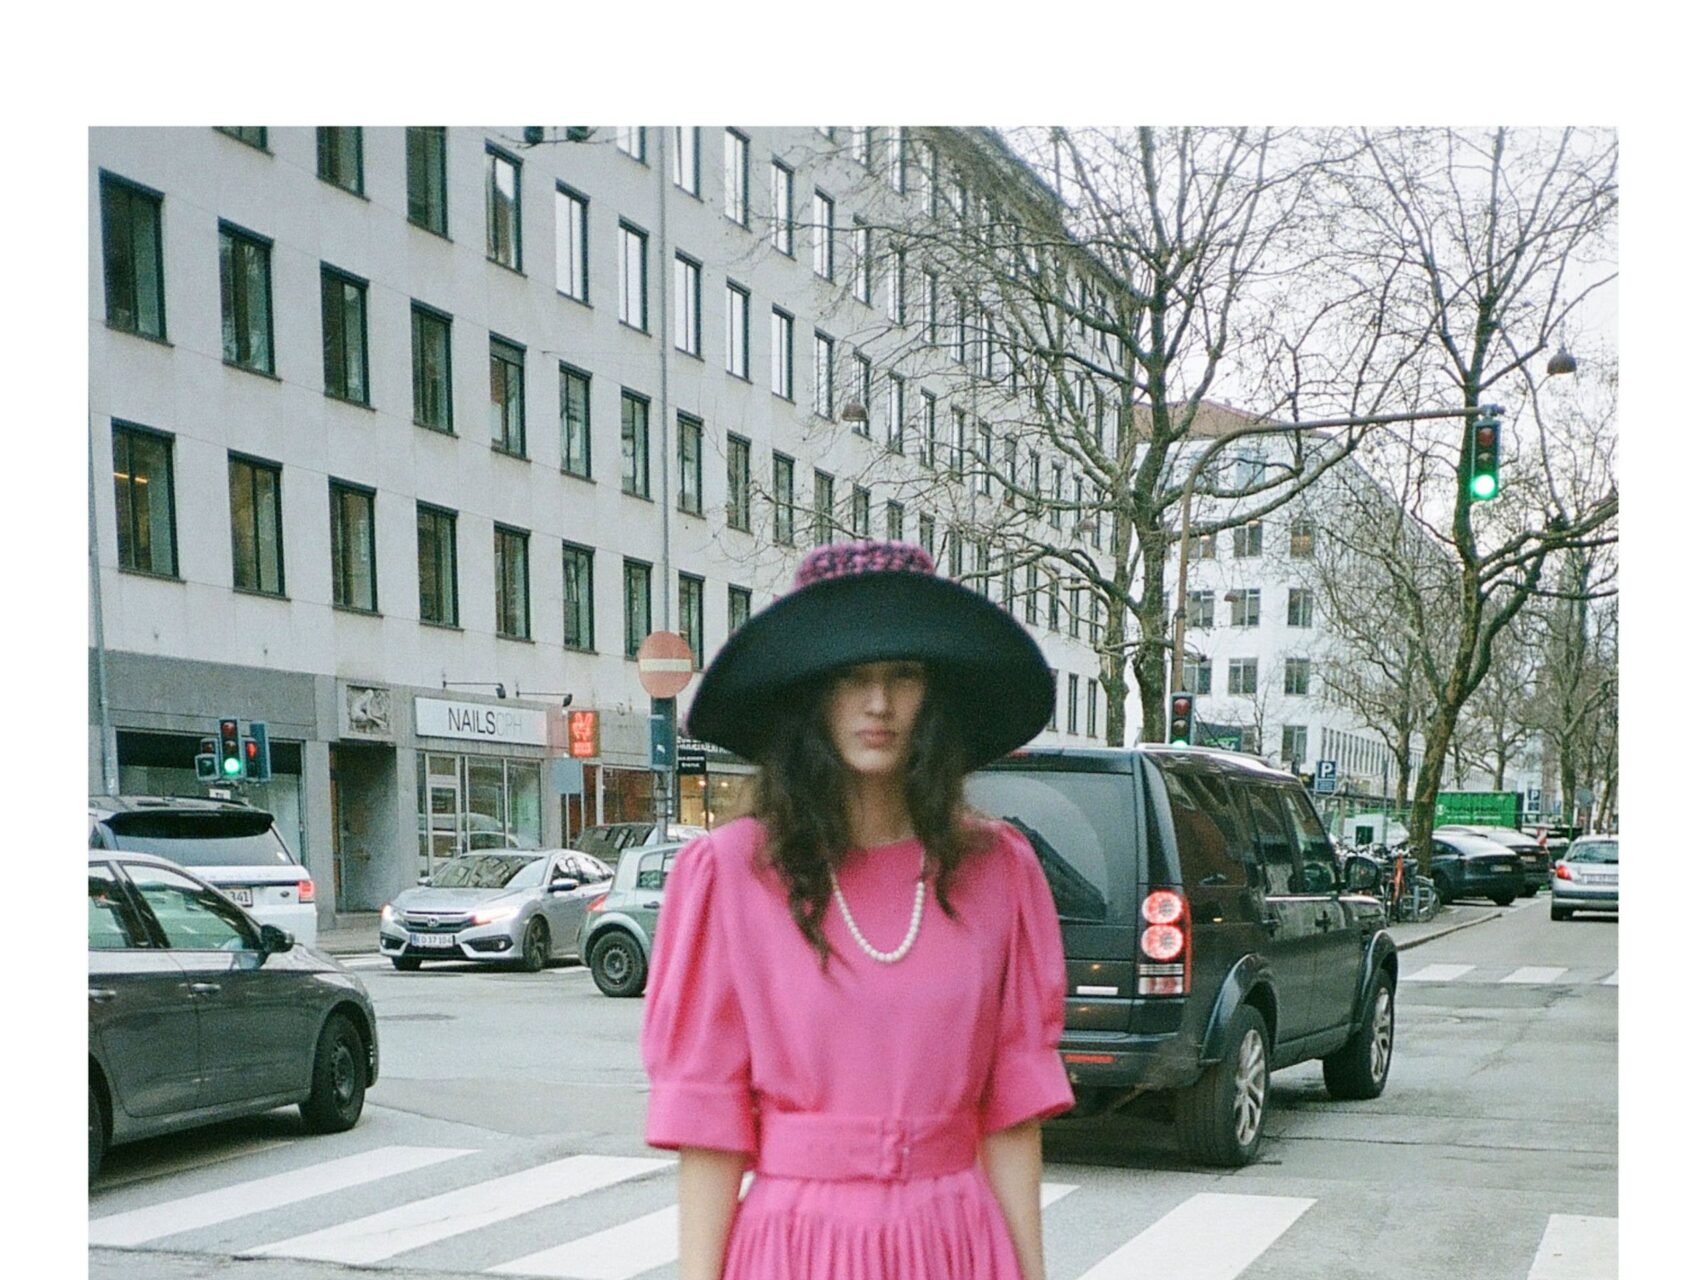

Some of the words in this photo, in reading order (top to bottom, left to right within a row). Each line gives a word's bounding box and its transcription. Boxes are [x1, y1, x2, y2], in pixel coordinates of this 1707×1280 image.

[448, 706, 496, 735] NAILS
[1321, 762, 1333, 777] P
[1531, 790, 1539, 801] P
